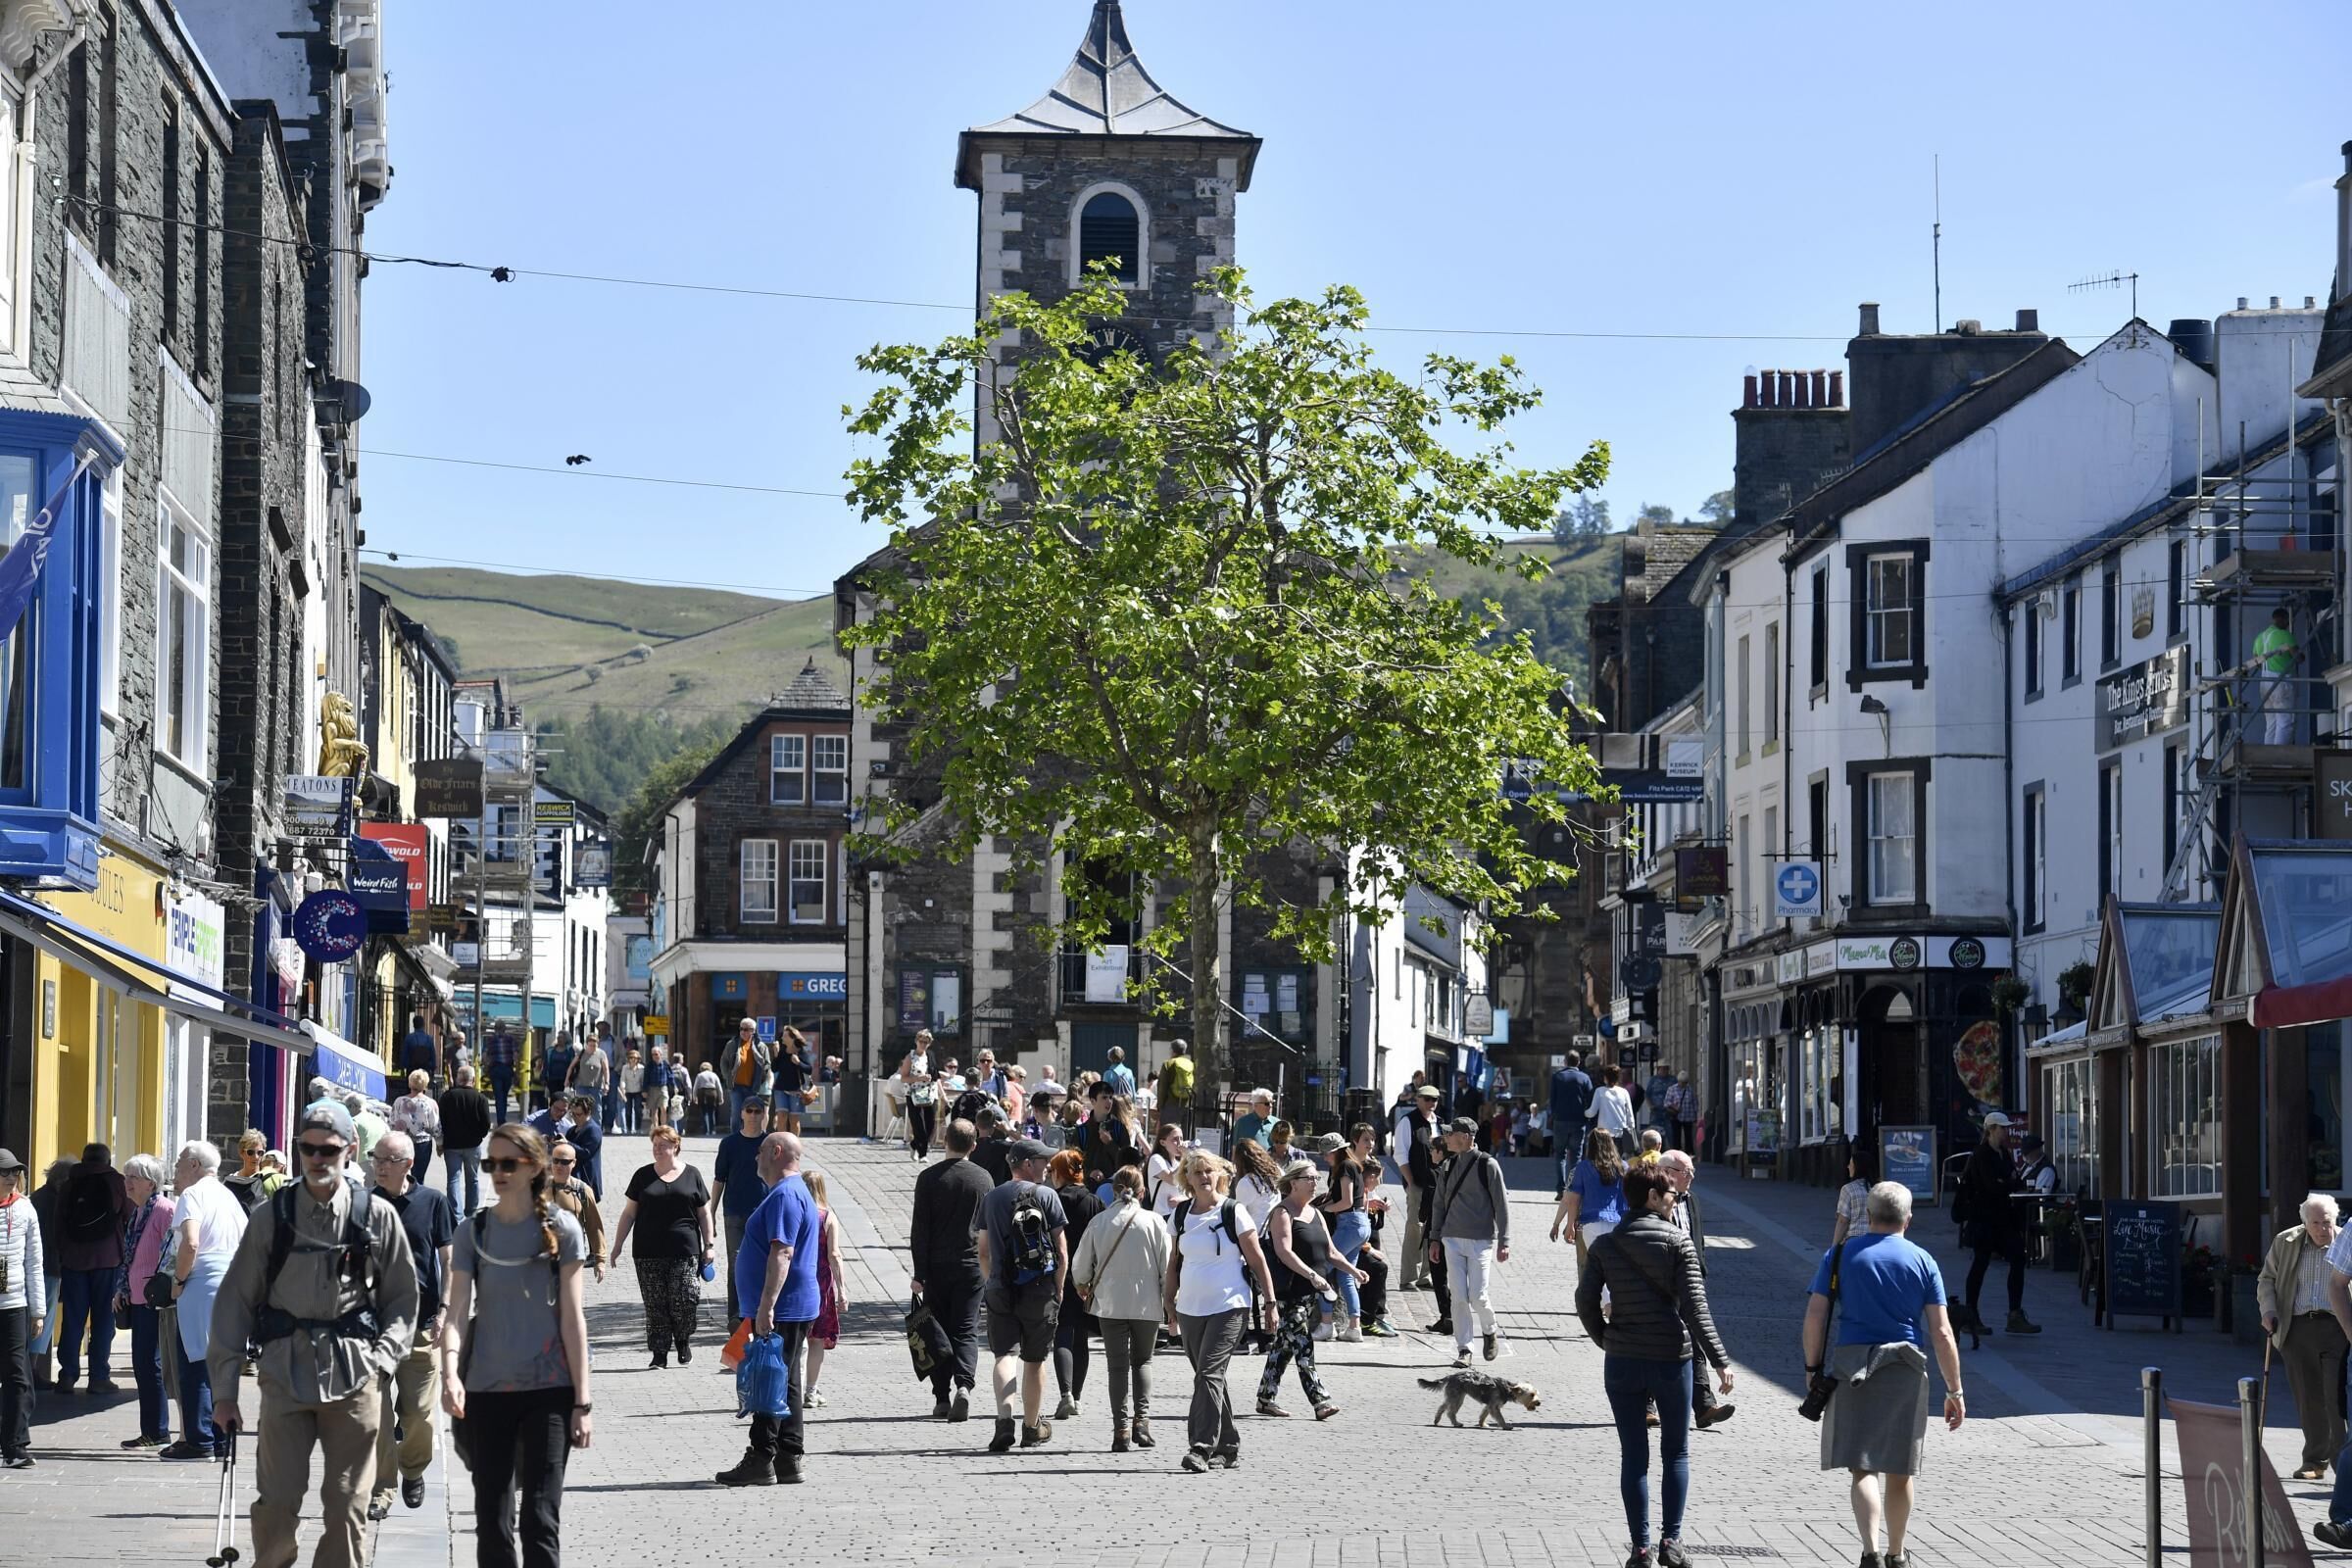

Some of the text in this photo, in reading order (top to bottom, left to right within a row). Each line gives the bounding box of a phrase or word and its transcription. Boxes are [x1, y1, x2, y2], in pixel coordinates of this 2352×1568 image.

[2107, 681, 2122, 711] The
[2122, 674, 2144, 710] Kings
[308, 827, 335, 836] 72370
[91, 865, 124, 914] OULES
[353, 876, 380, 888] Weird
[380, 877, 398, 889] Fish
[1778, 906, 1818, 915] Pharmacy
[808, 979, 846, 993] GREG
[2133, 1221, 2164, 1241] Music
[2205, 1461, 2294, 1568] Resh
